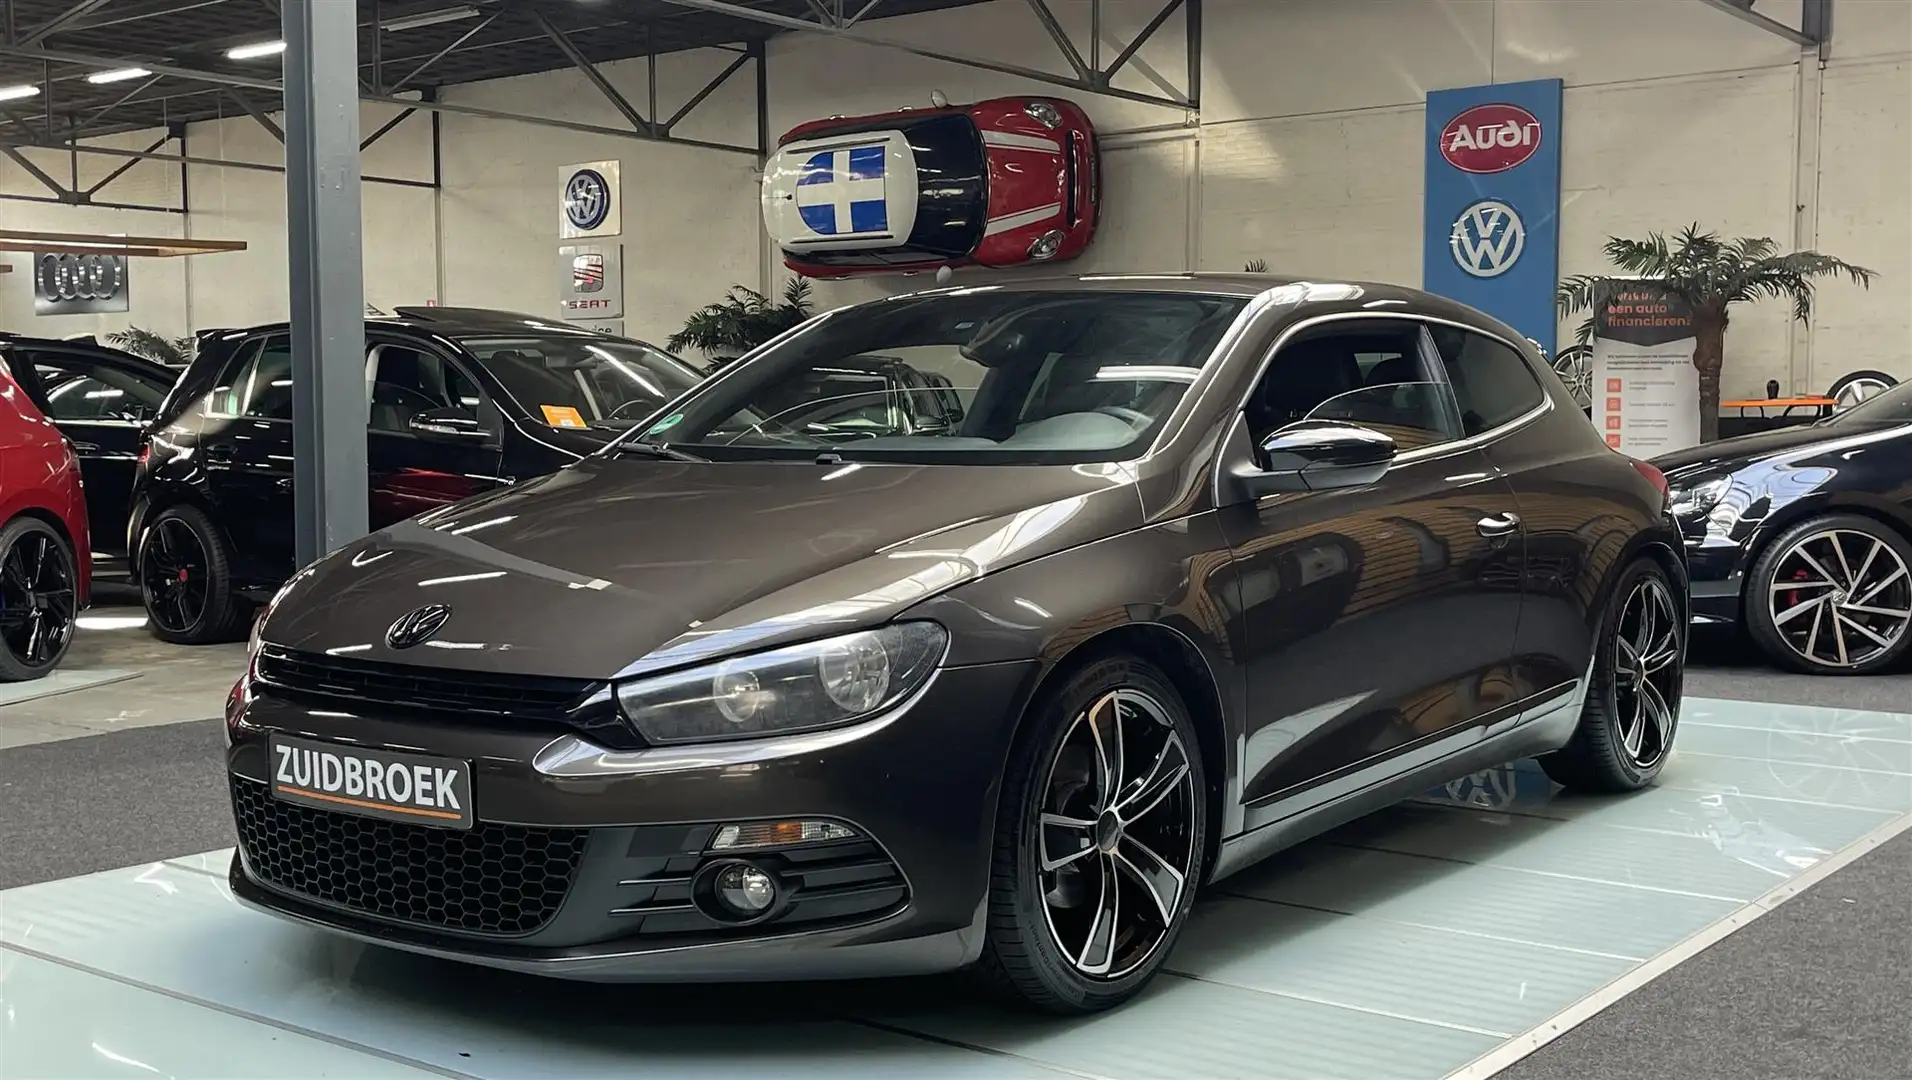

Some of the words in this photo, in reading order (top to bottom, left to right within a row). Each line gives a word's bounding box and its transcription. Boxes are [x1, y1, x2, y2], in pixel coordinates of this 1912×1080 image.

[1449, 119, 1532, 152] Audi
[1452, 201, 1525, 277] VW
[568, 299, 611, 310] SEAT
[1607, 304, 1633, 314] een
[1635, 302, 1668, 314] auto
[276, 744, 461, 810] ZUIDBROEK
